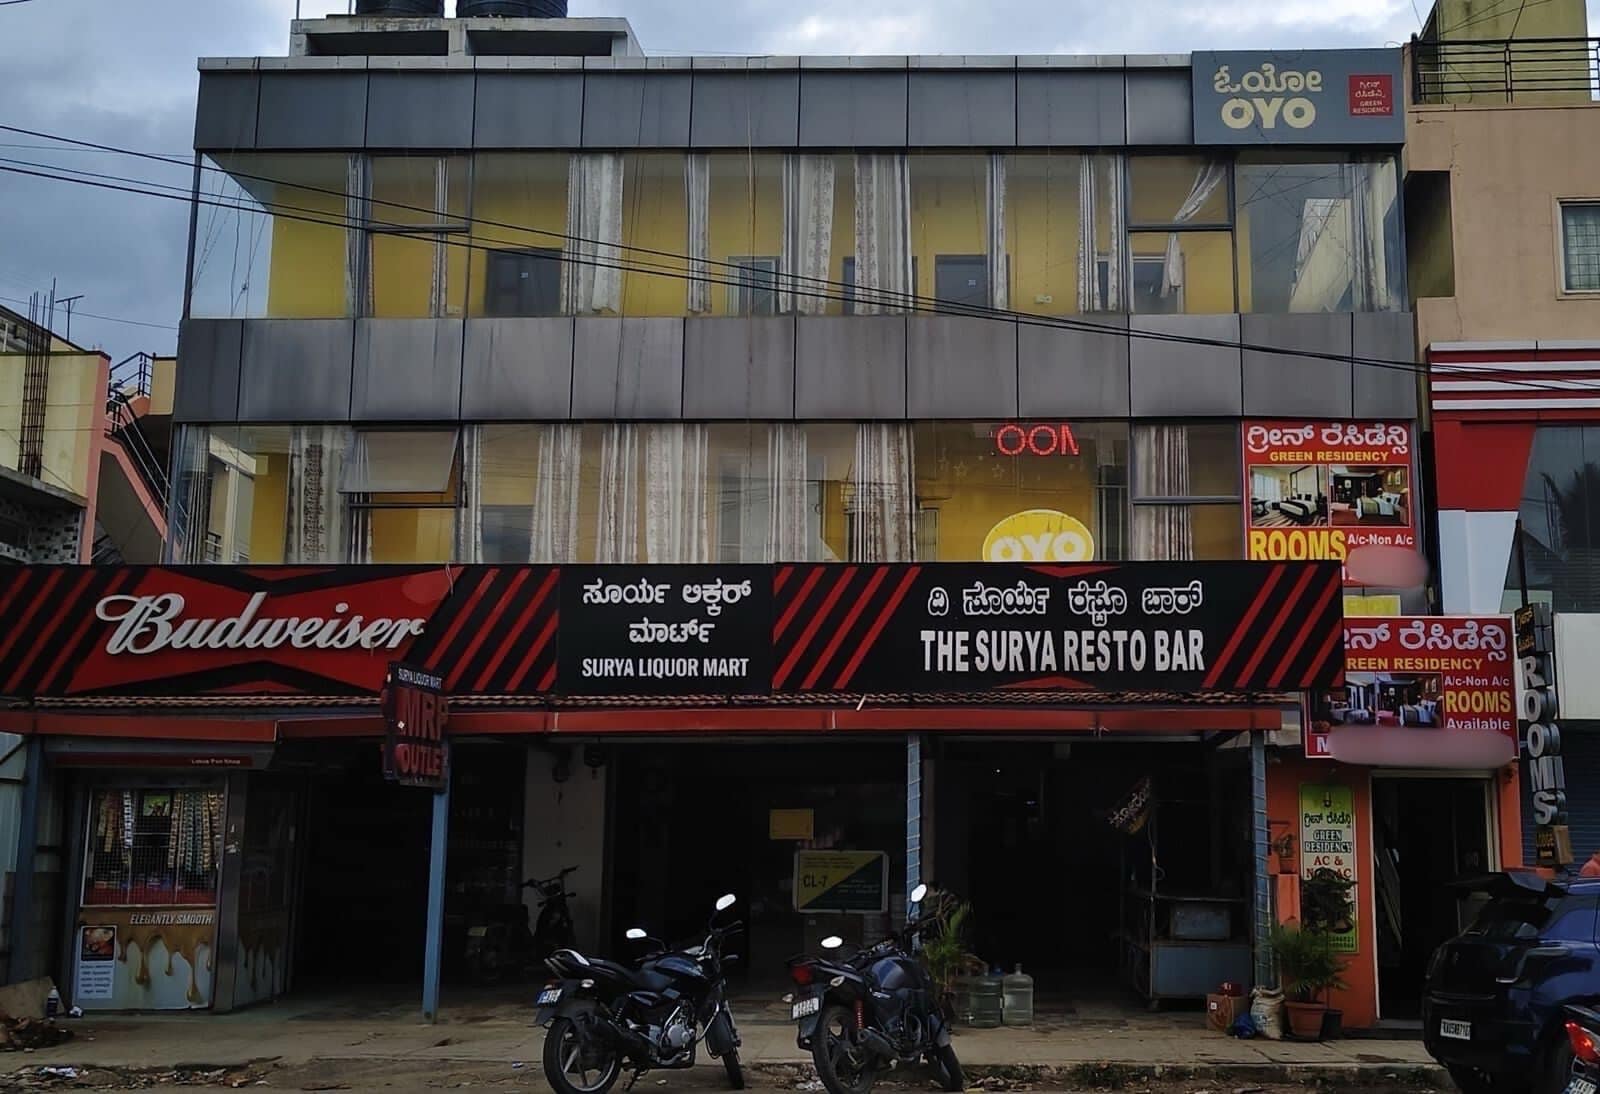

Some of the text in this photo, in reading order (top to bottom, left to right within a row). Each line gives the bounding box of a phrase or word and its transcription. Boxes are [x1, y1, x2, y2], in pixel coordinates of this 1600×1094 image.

[1214, 62, 1322, 93] ಓಯೋ
[1221, 97, 1316, 129] OYO
[1352, 106, 1390, 114] RESIDENCY
[1247, 424, 1314, 453] ಗ್ರೀನ್
[1269, 451, 1389, 462] GREEN RESIDENCY
[990, 531, 1086, 562] OYO
[1250, 530, 1346, 560] ROOMS
[1394, 534, 1414, 545] A/c
[583, 578, 752, 616] ಸೂರ್ಯ ಲಿಕ್ಕರ್
[963, 581, 1050, 615] ಸೂರ್ಯ
[1142, 580, 1203, 615] ಬಾರ್
[95, 591, 426, 655] Budweiser
[629, 617, 715, 643] ಮಾರ್ಟ್
[921, 629, 1205, 672] THE SURYA RESTO BAR
[582, 658, 750, 679] SURYA LIQUOR MART
[1347, 657, 1483, 670] REEN RESIDENCY
[398, 667, 443, 689] SURYA LIQUOR MART
[1491, 676, 1510, 687] A/c
[1445, 690, 1511, 713] ROOMS
[396, 687, 449, 740] MRP
[1447, 718, 1511, 731] Available
[1521, 655, 1559, 825] ROOMS
[1304, 841, 1353, 853] RESIDENCY
[1313, 830, 1343, 842] GREEN
[1313, 856, 1344, 866] AC &
[803, 875, 828, 888] CL-7
[130, 913, 213, 925] ELEGANTLY SMOOTH
